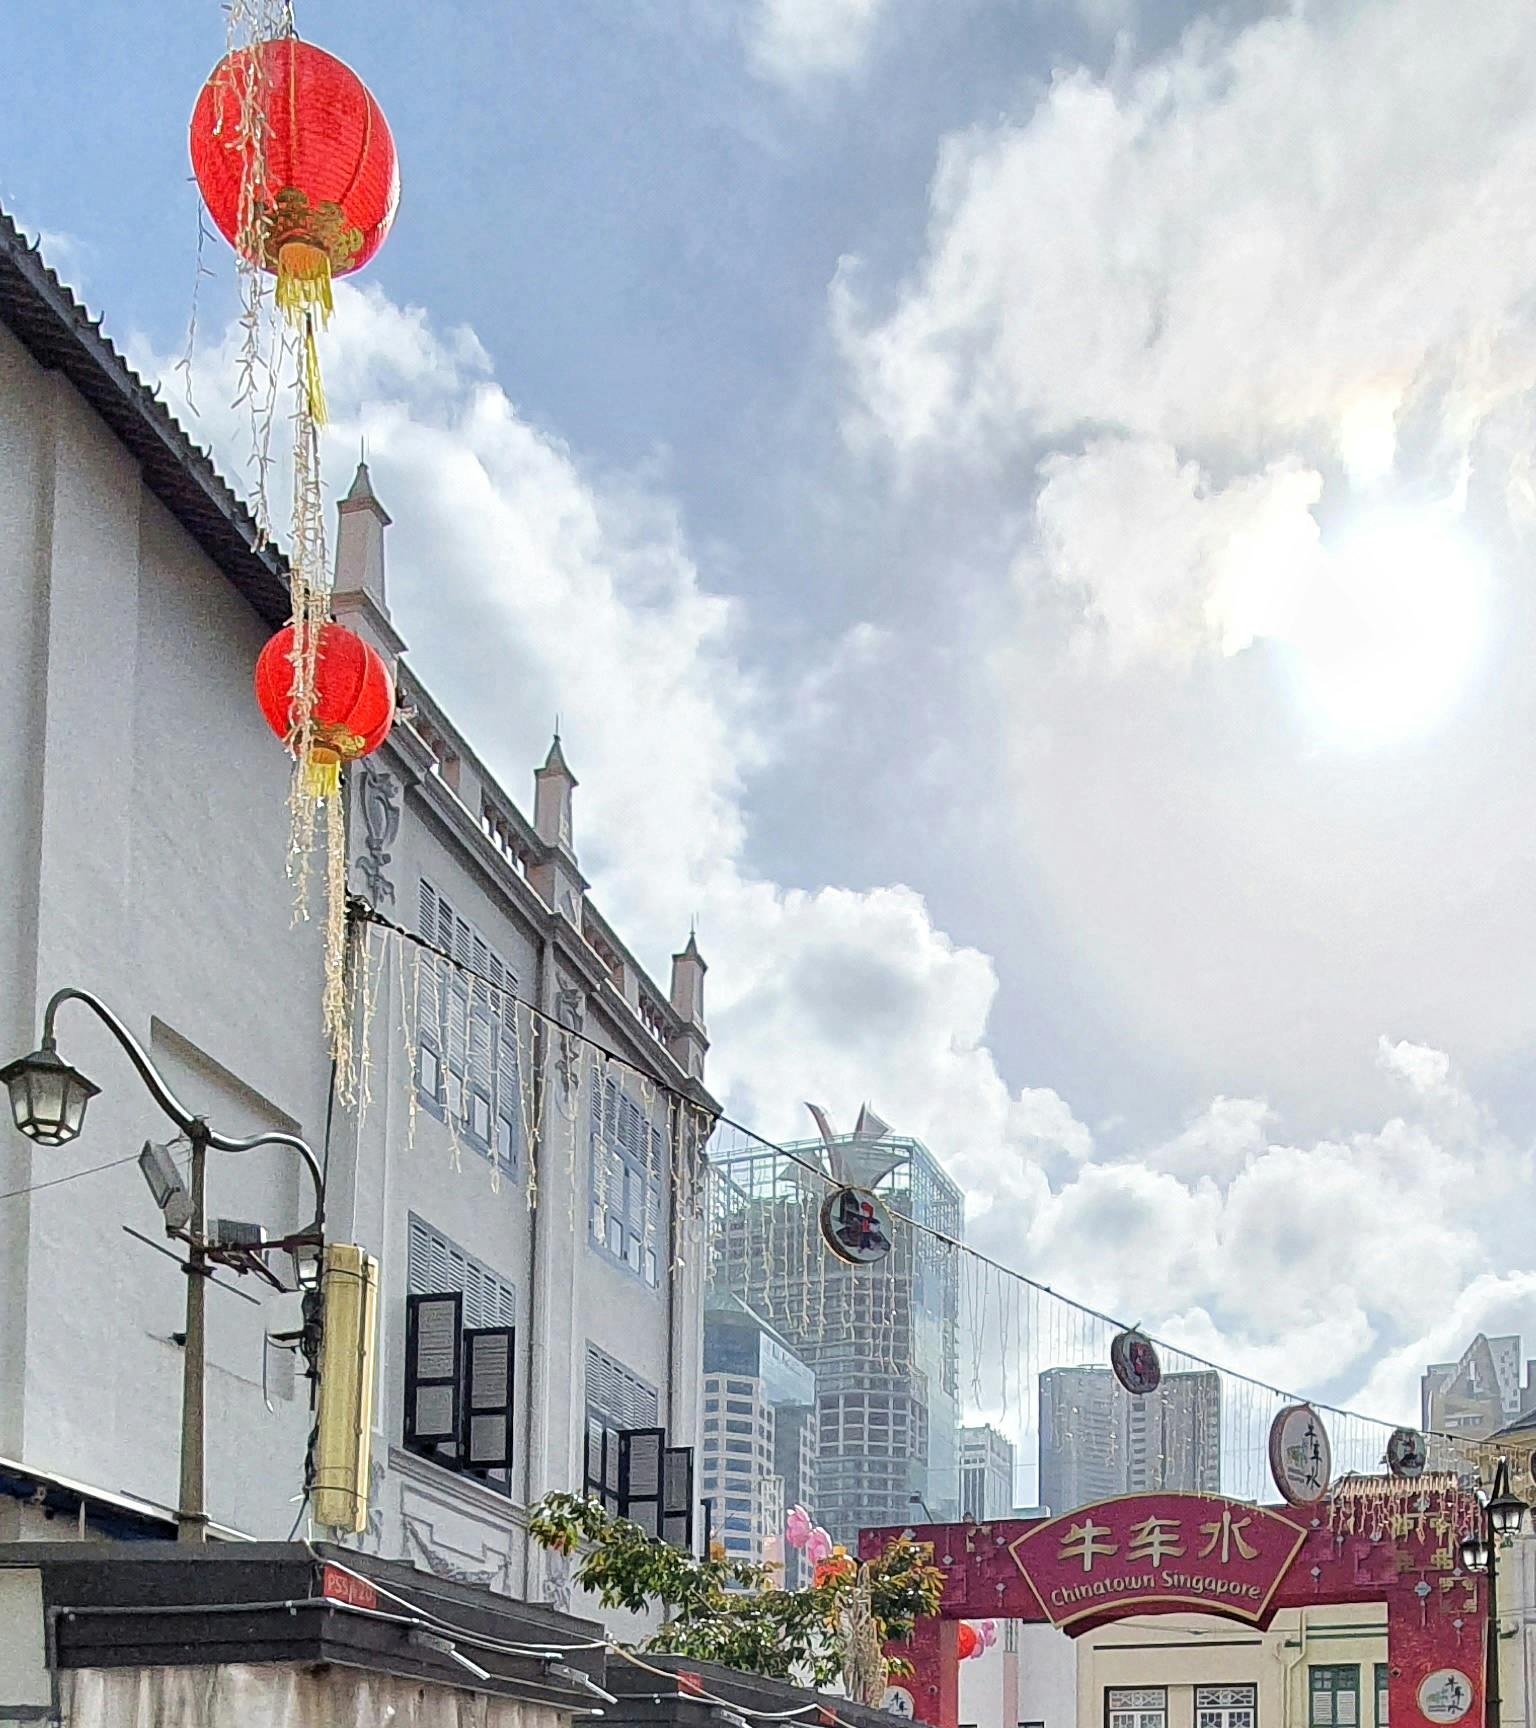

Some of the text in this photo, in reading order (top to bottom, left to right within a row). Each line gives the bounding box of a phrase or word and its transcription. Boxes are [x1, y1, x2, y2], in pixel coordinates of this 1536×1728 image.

[1056, 1509, 1262, 1573] 牛车水
[1050, 1570, 1262, 1607] Chinatown Singapore
